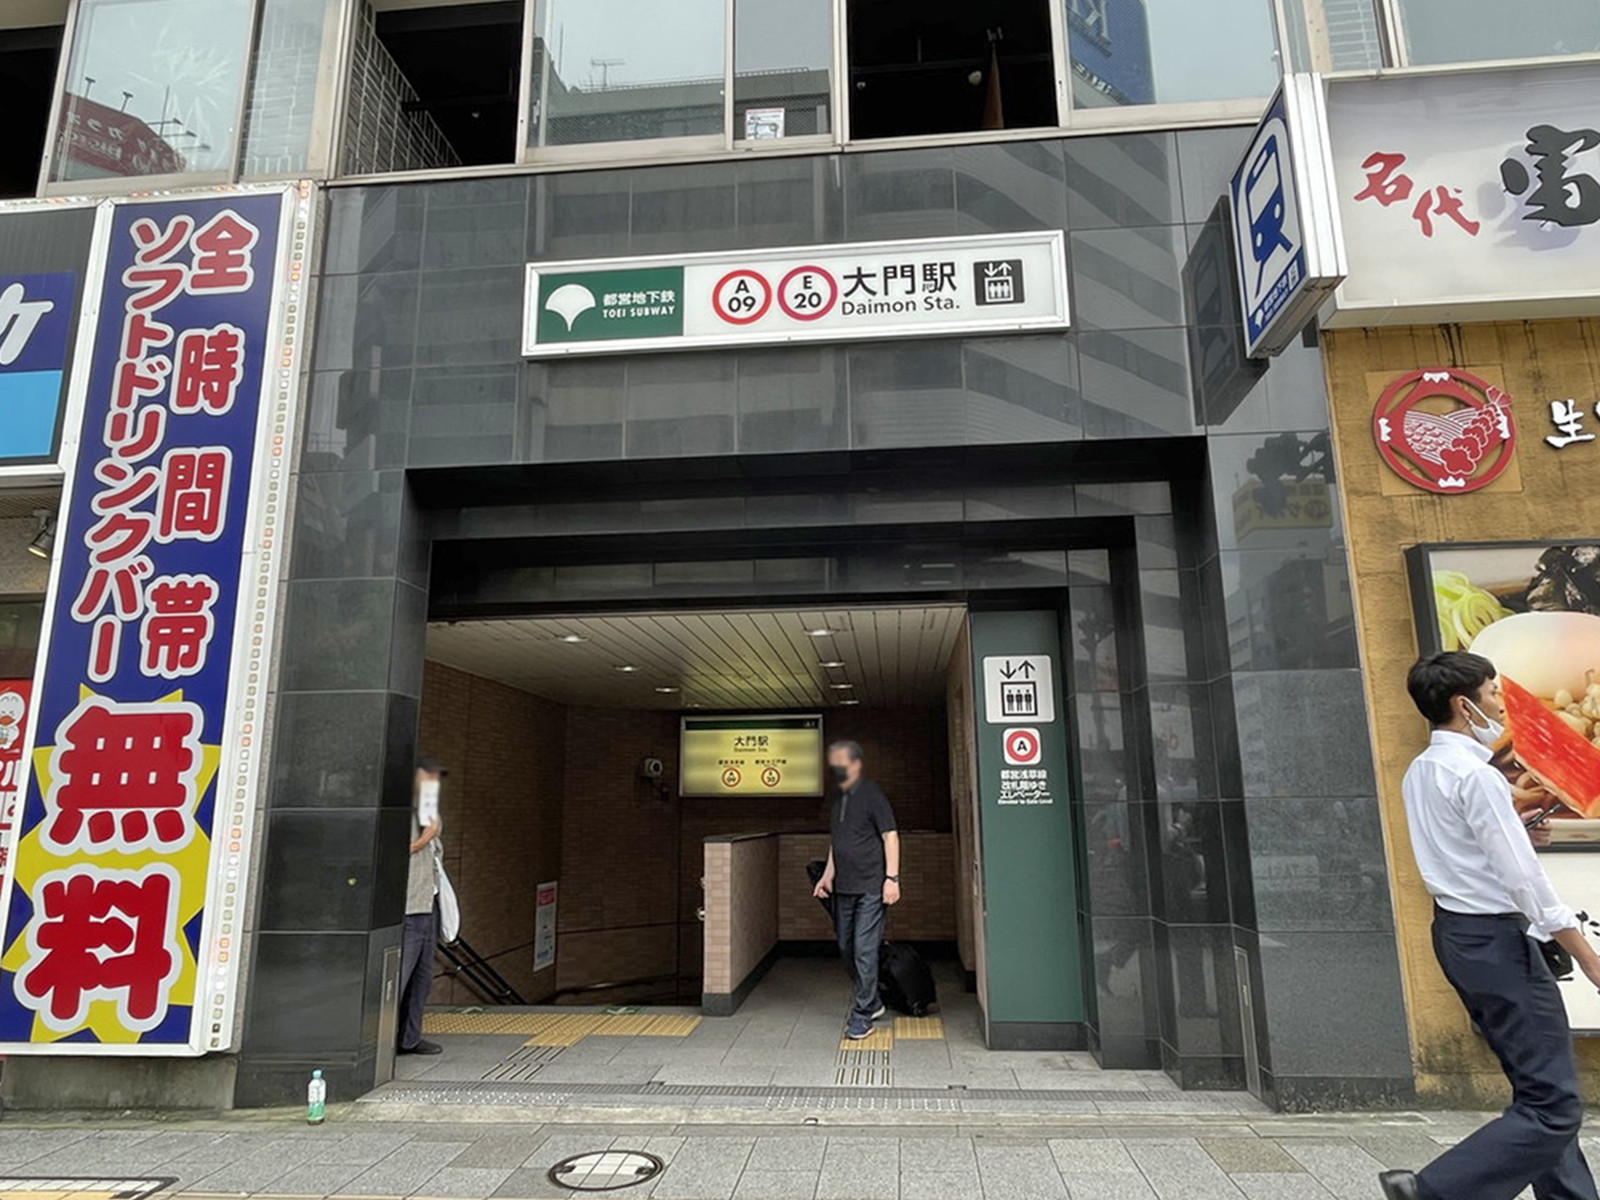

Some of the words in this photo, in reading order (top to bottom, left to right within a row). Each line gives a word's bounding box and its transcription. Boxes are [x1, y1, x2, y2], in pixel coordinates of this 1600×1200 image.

[1354, 151, 1480, 238] 名代
[735, 279, 750, 294] A
[803, 275, 812, 290] E
[843, 262, 958, 298] 大門駅
[603, 290, 676, 306] 都営地下鉄
[728, 296, 757, 312] 09
[794, 292, 822, 309] 20
[842, 299, 916, 316] Daimon
[923, 296, 960, 311] Sta.
[603, 308, 627, 319] TOEI
[630, 305, 676, 317] SUBWAY
[1545, 399, 1600, 449] 生
[71, 215, 194, 682] ソフトドリンクバー
[140, 209, 258, 678] 全時間帯
[734, 735, 769, 747] 大門駅
[1017, 740, 1028, 752] A
[1000, 790, 1051, 799] エレベーター
[13, 697, 203, 1031] 無料
